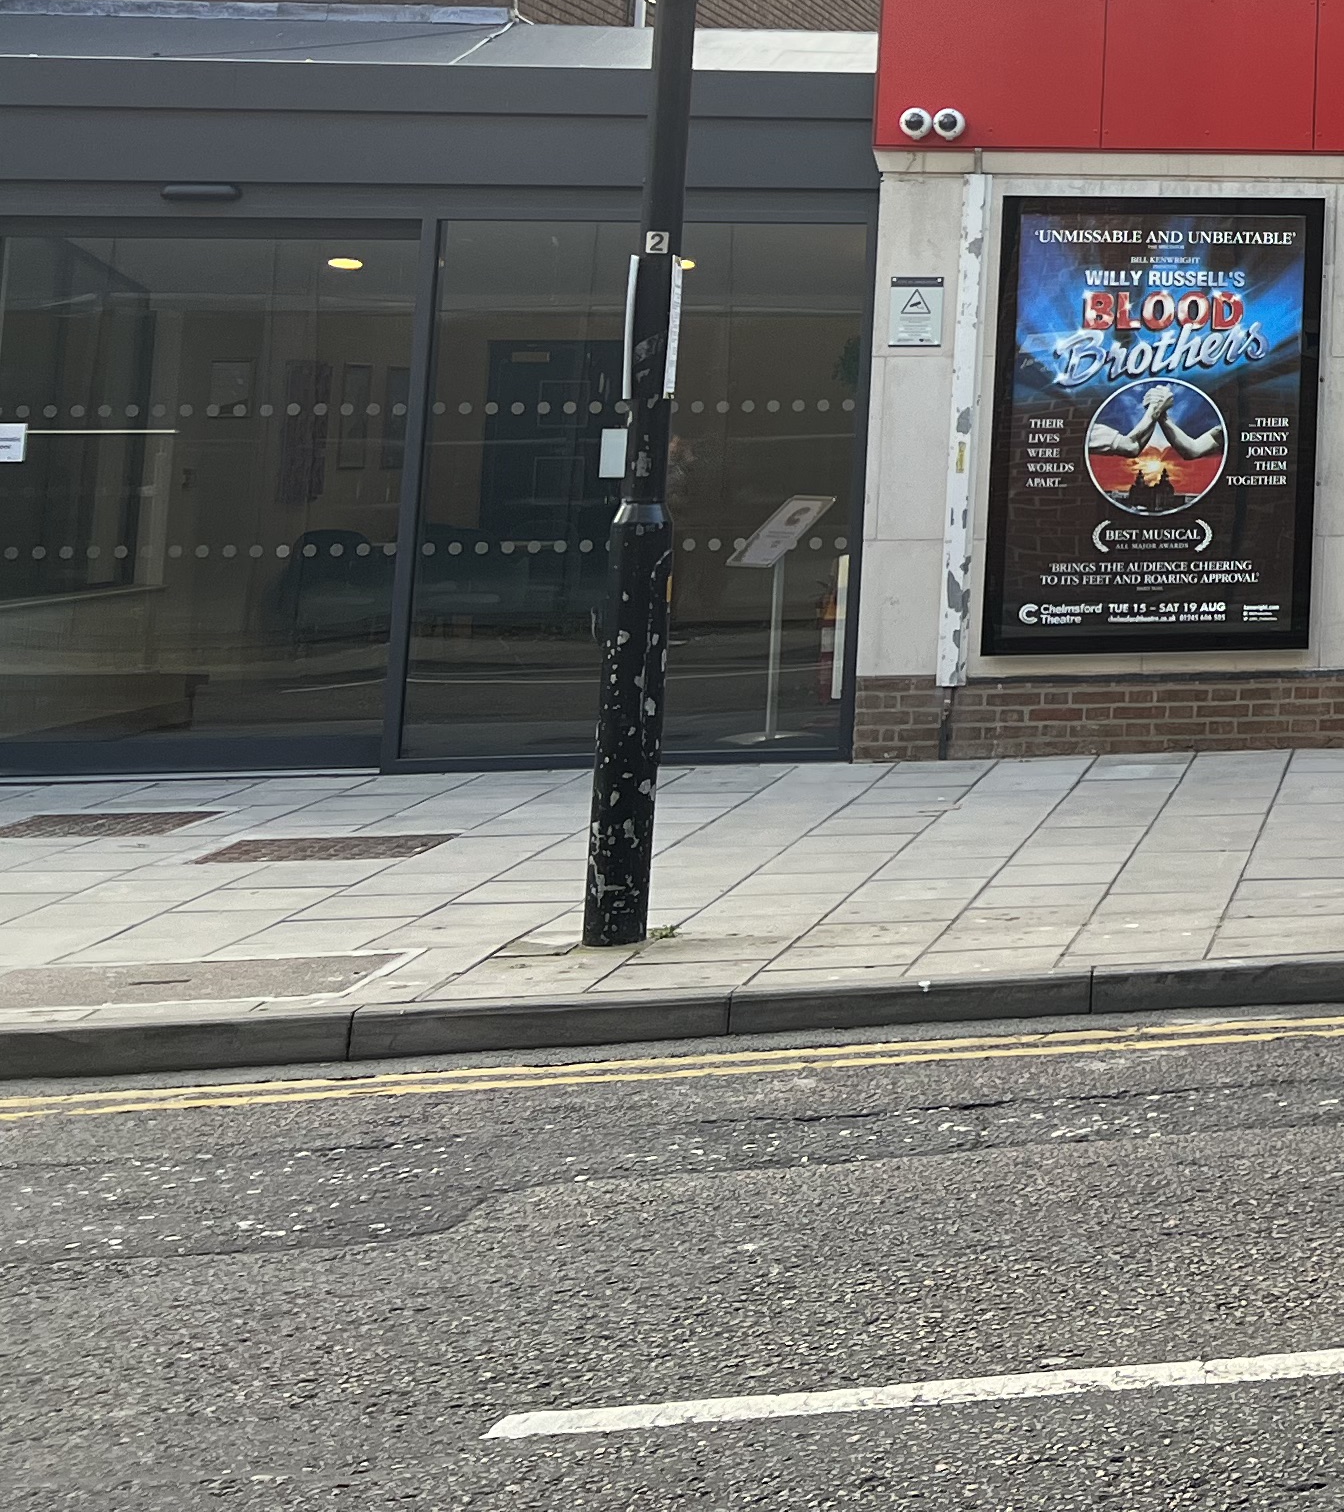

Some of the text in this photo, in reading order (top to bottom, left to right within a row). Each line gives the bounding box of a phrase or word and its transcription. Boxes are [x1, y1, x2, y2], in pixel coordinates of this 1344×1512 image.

[649, 233, 665, 252] 2
[1146, 231, 1183, 243] AND
[1131, 256, 1201, 264] BILL KENWRIGHT
[1085, 271, 1246, 287] WILLY RUSSELL'S
[1082, 290, 1245, 331] BLOOD
[1053, 321, 1268, 386] Brothers
[1029, 418, 1064, 428] THEIR
[1028, 433, 1060, 443] LIVES
[1241, 432, 1289, 442] DESTINY
[1027, 448, 1060, 458] WERE
[1246, 446, 1288, 458] JOINED
[1027, 462, 1075, 473] WORLDS
[1254, 461, 1287, 471] THEM
[1226, 475, 1287, 485] TOGETHER
[1105, 529, 1200, 540] BEST MUSICAL
[1099, 562, 1125, 572] THE
[1127, 561, 1188, 572] AUDIENCE
[1190, 560, 1252, 571] CHEERING
[1040, 575, 1058, 585] TO
[1060, 575, 1079, 585] ITS
[1082, 574, 1112, 585] FEET
[1113, 574, 1141, 584] AND
[1144, 573, 1198, 584] ROARING
[1040, 603, 1103, 613] Chelmsford
[1108, 603, 1129, 613] TUE
[1133, 603, 1147, 612] 15
[1159, 603, 1180, 612] SAT
[1183, 603, 1198, 612] 19
[1200, 602, 1226, 611] AUG
[1040, 614, 1082, 624] Theatre
